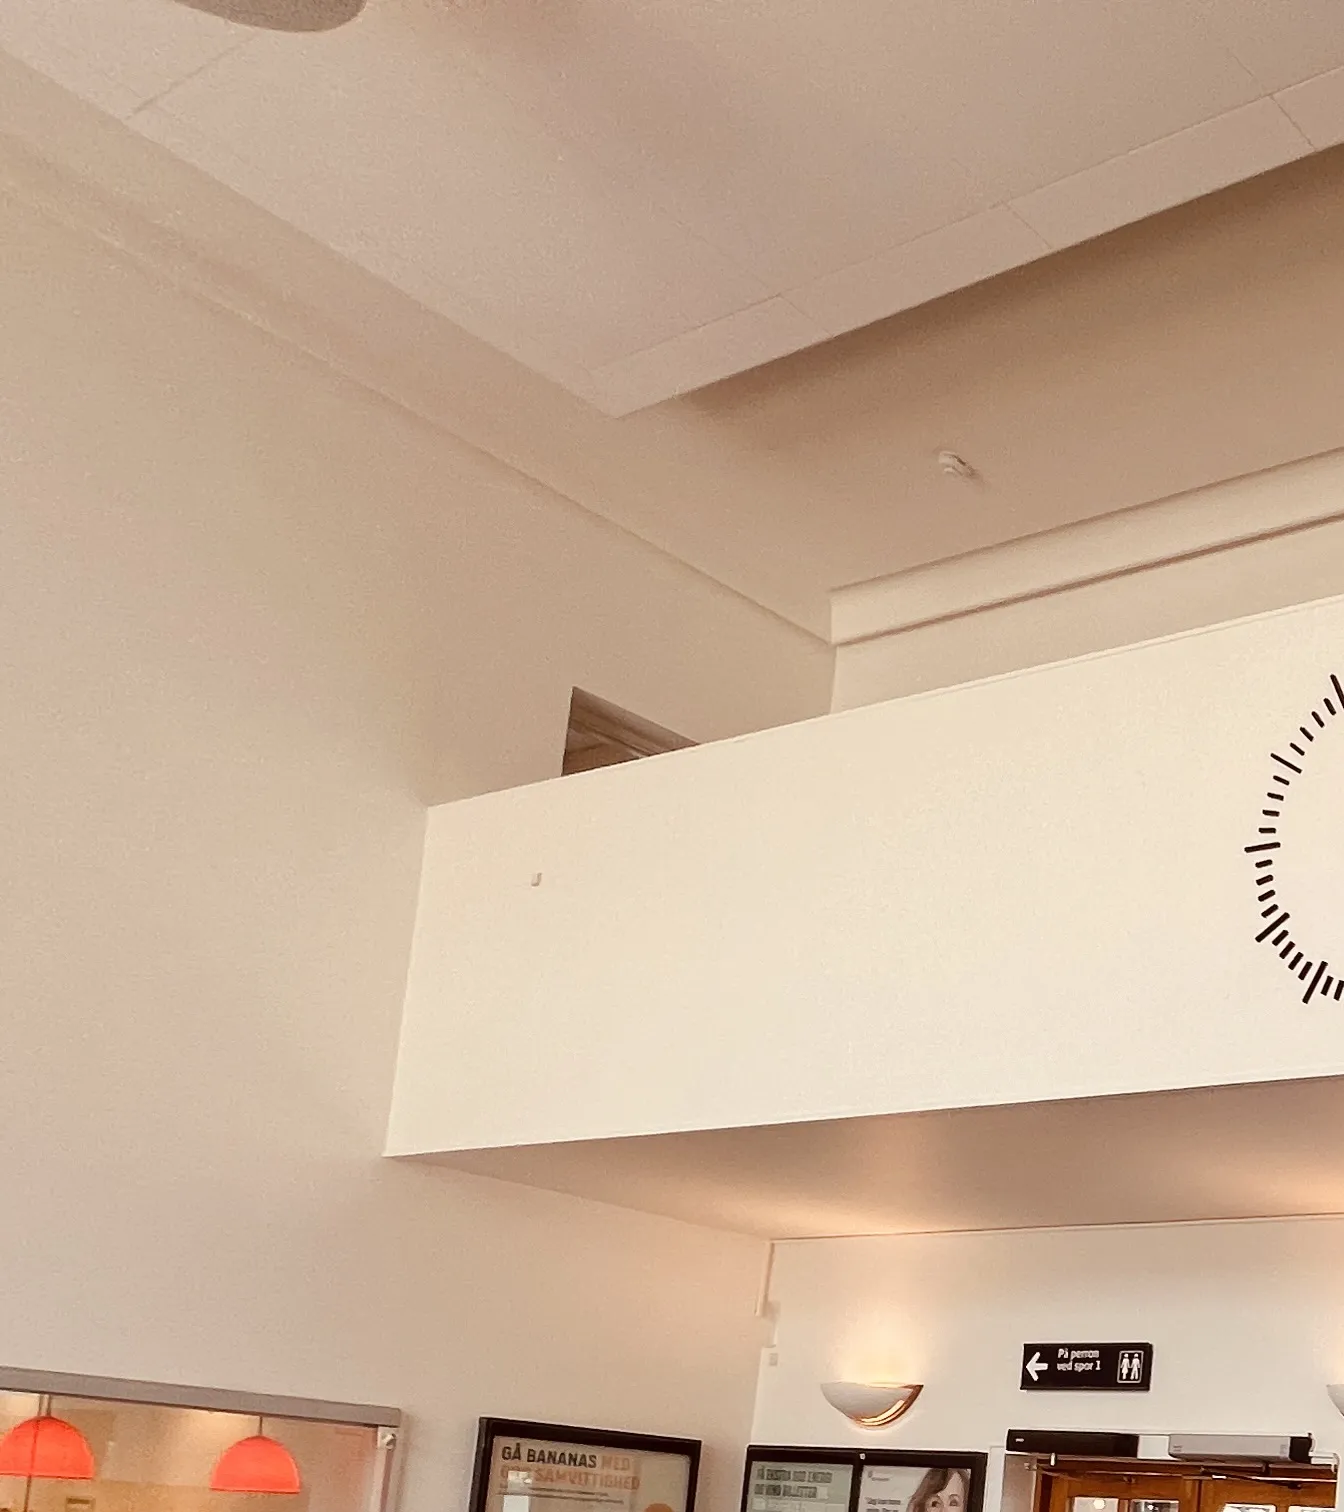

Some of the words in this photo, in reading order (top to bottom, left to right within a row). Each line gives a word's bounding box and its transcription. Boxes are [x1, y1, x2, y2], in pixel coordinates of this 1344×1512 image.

[1074, 1363, 1094, 1372] spor
[1095, 1360, 1101, 1371] 1
[501, 1443, 522, 1461] GÅ
[526, 1449, 597, 1469] BANANAS
